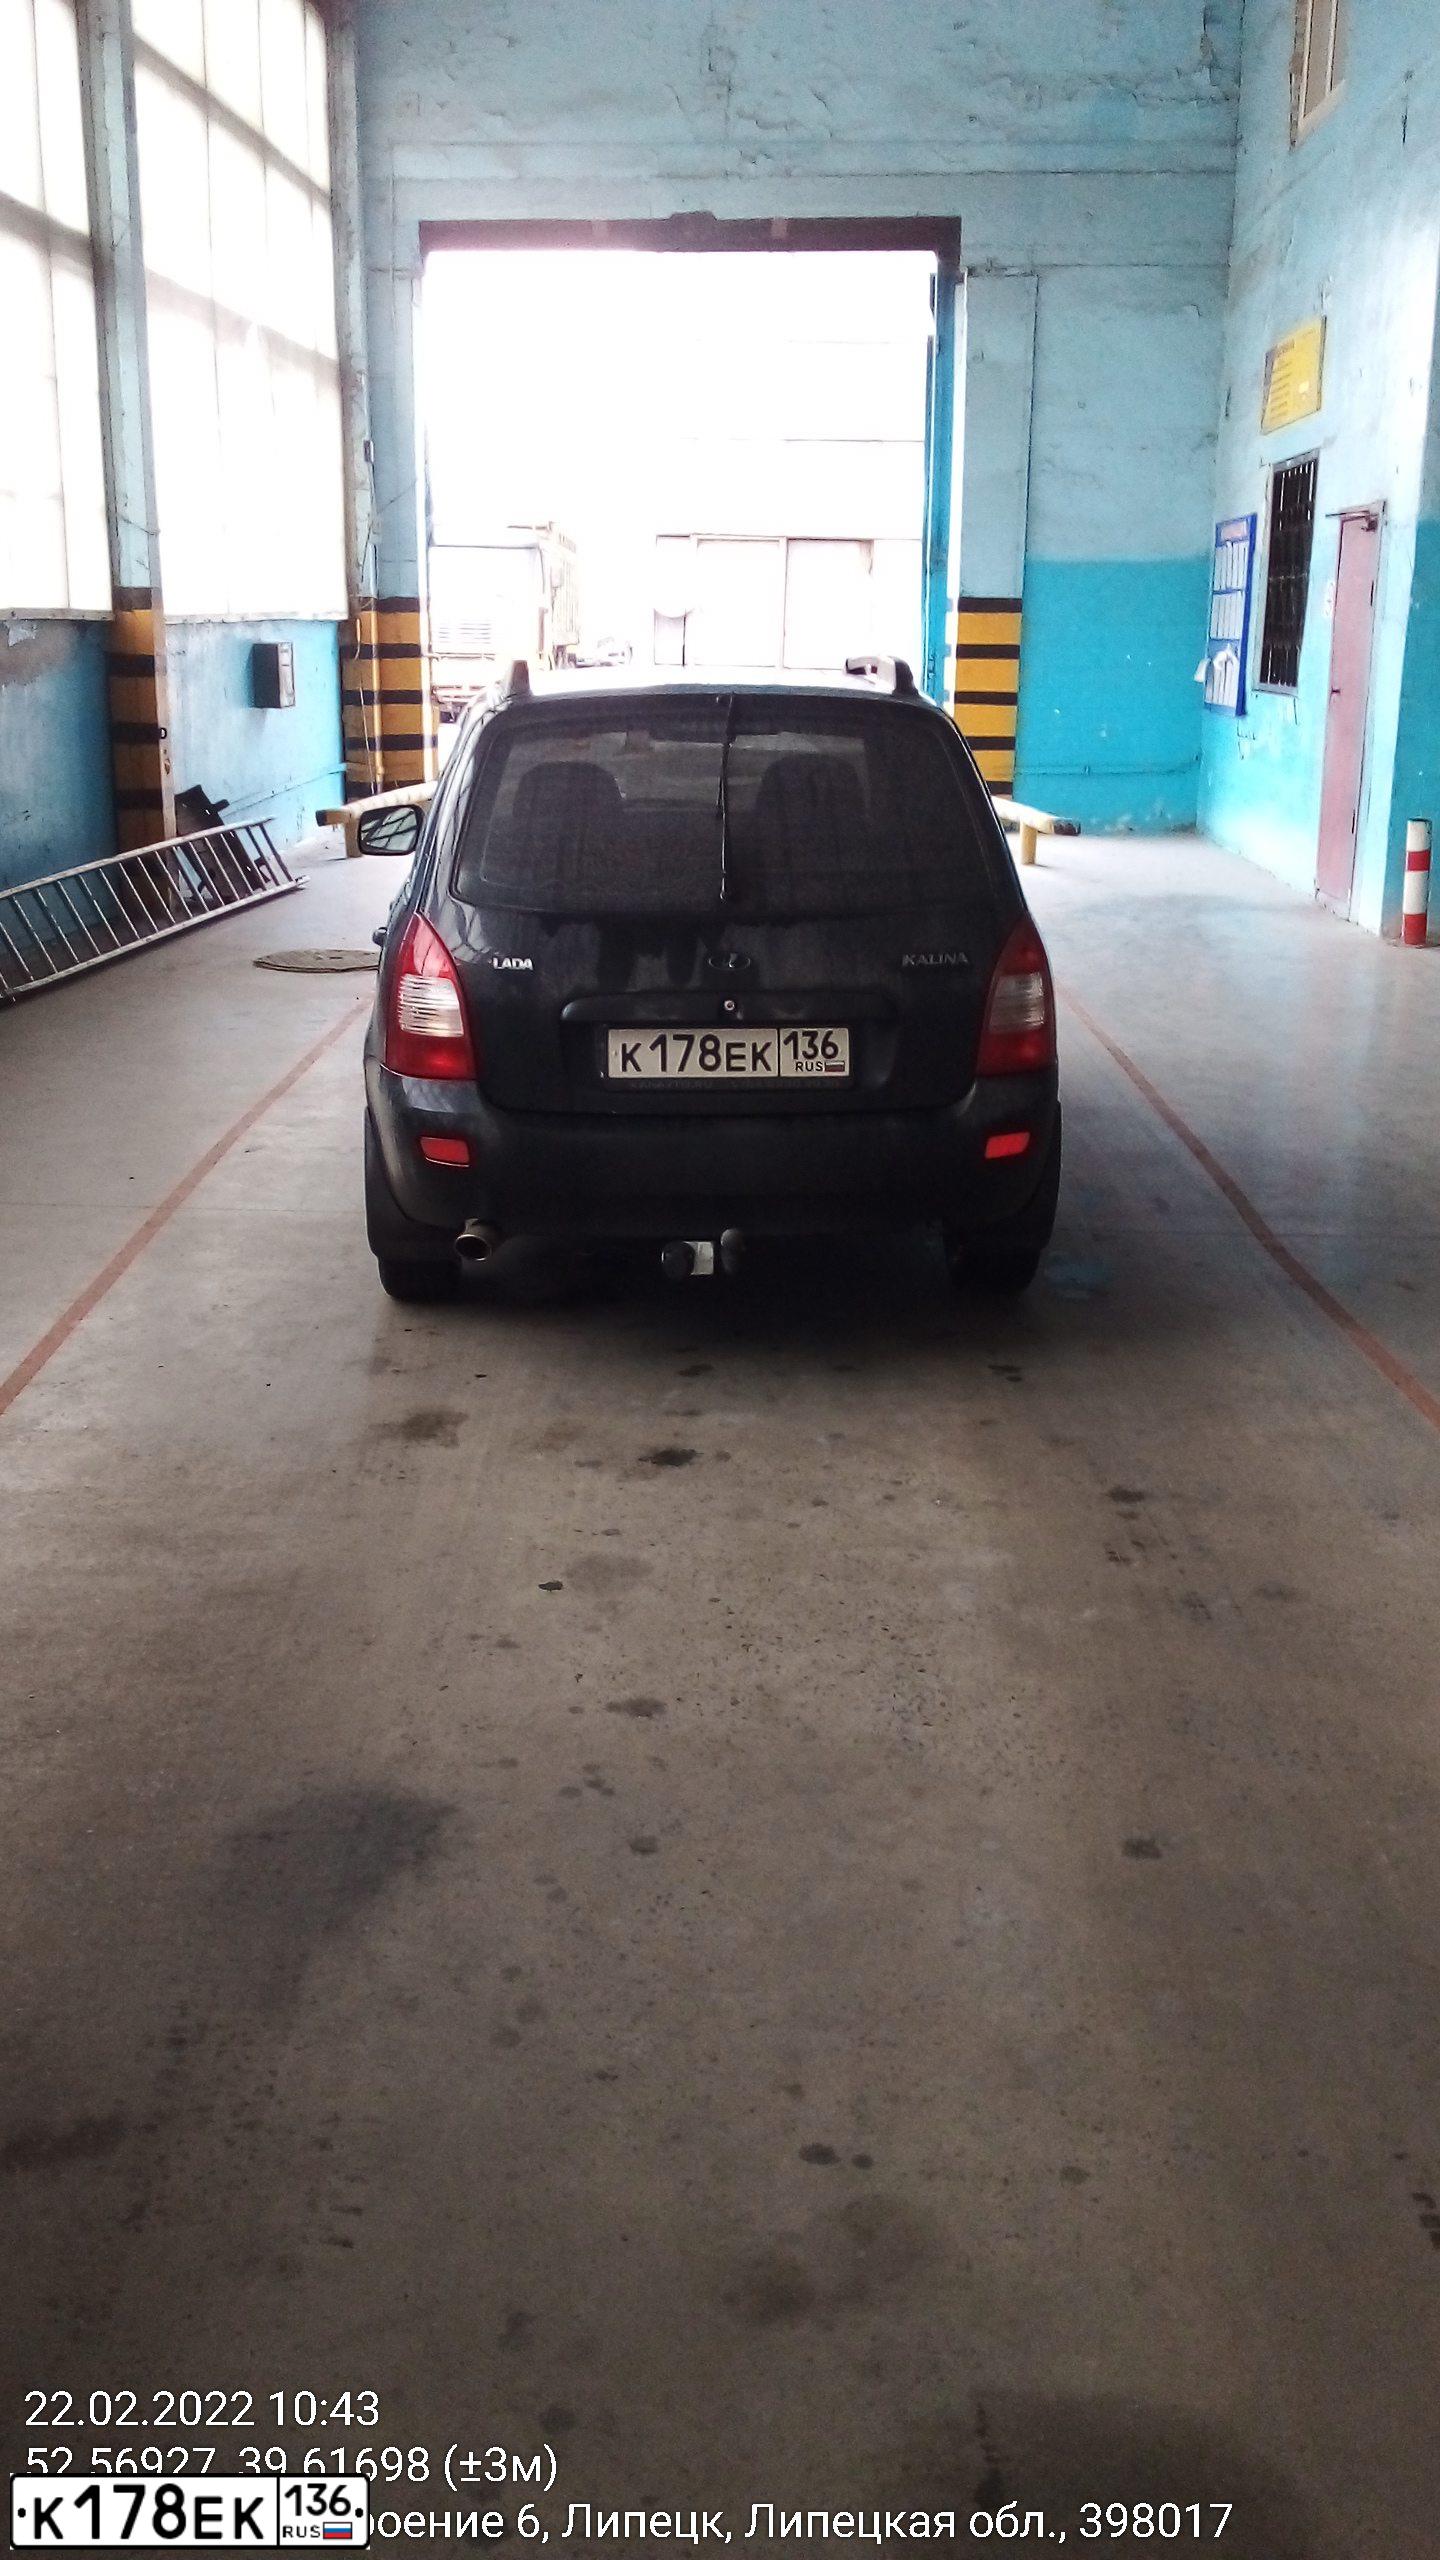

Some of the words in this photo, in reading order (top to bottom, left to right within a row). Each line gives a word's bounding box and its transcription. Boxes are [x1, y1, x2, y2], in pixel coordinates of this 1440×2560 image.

[493, 957, 534, 970] LADA
[902, 952, 968, 967] KALINA
[783, 1030, 839, 1060] 136
[795, 1061, 823, 1072] RUS
